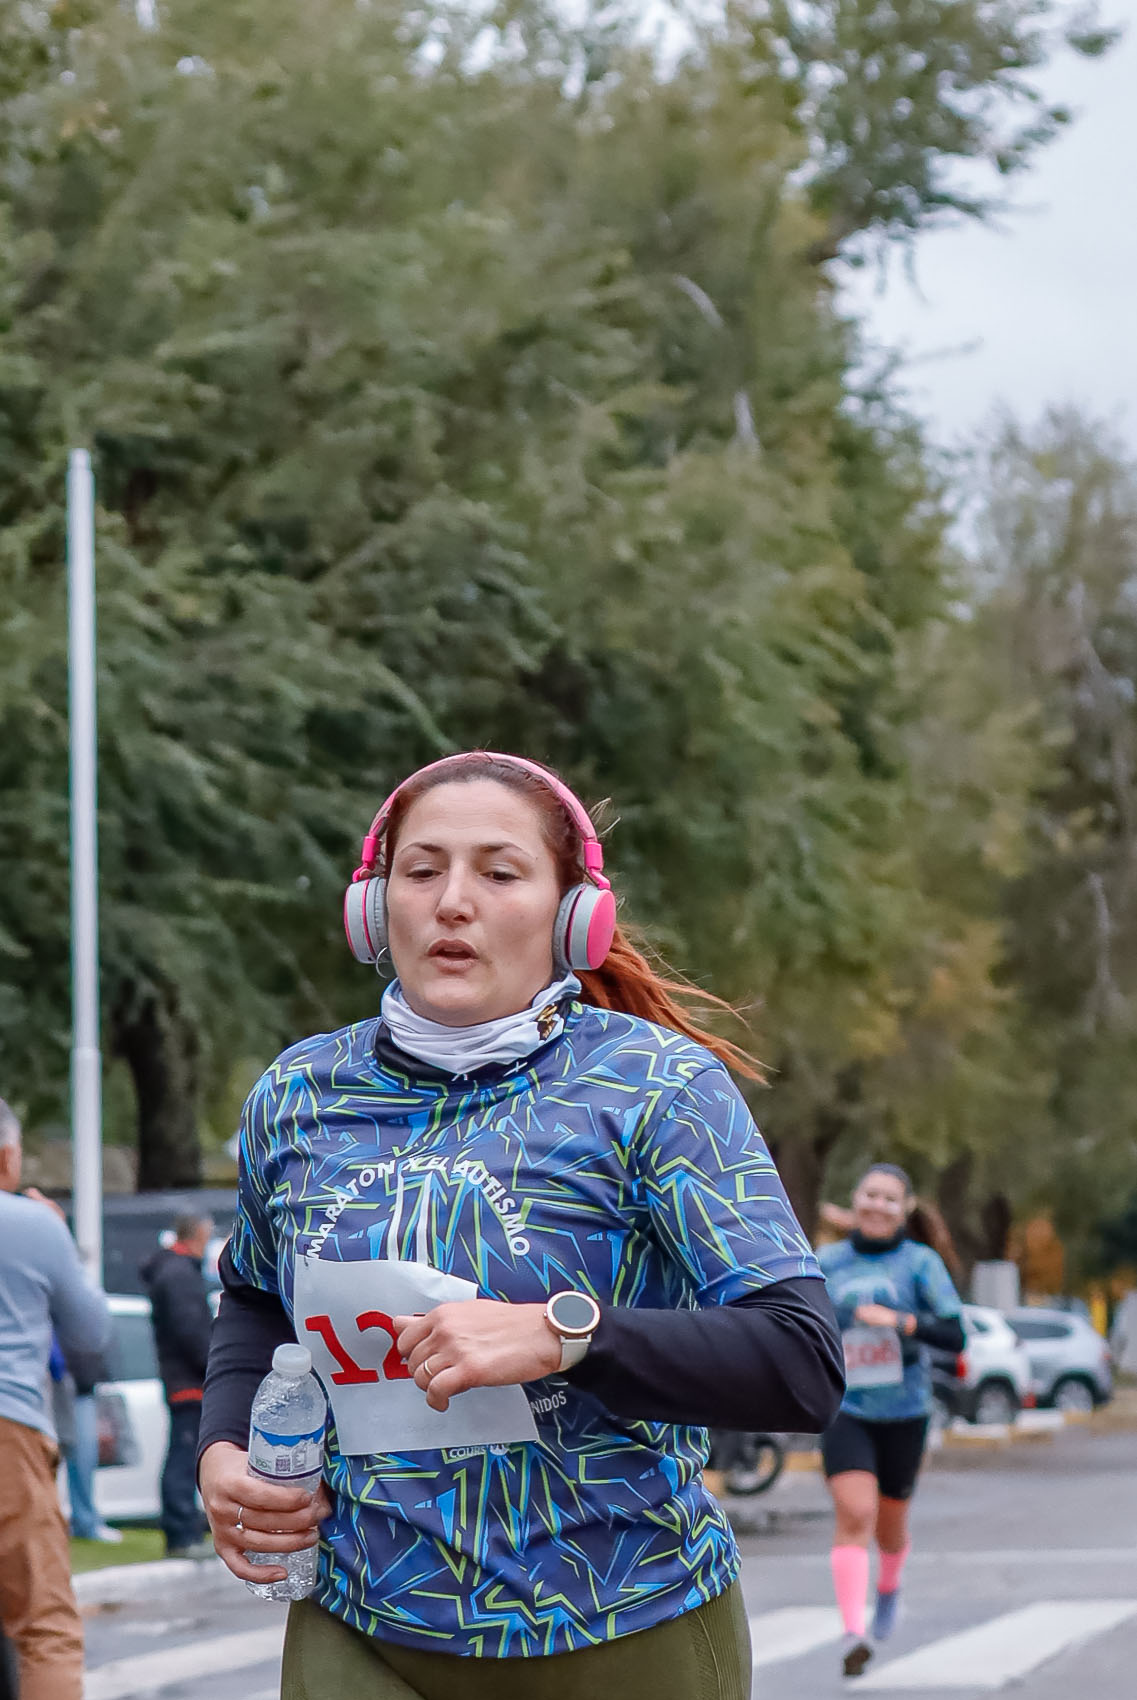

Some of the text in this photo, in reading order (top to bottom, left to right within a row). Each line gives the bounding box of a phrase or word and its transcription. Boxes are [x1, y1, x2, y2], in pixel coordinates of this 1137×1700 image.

[451, 1159, 531, 1256] AUTISMO
[304, 1310, 426, 1386] 12
[530, 1390, 567, 1414] NIDOS
